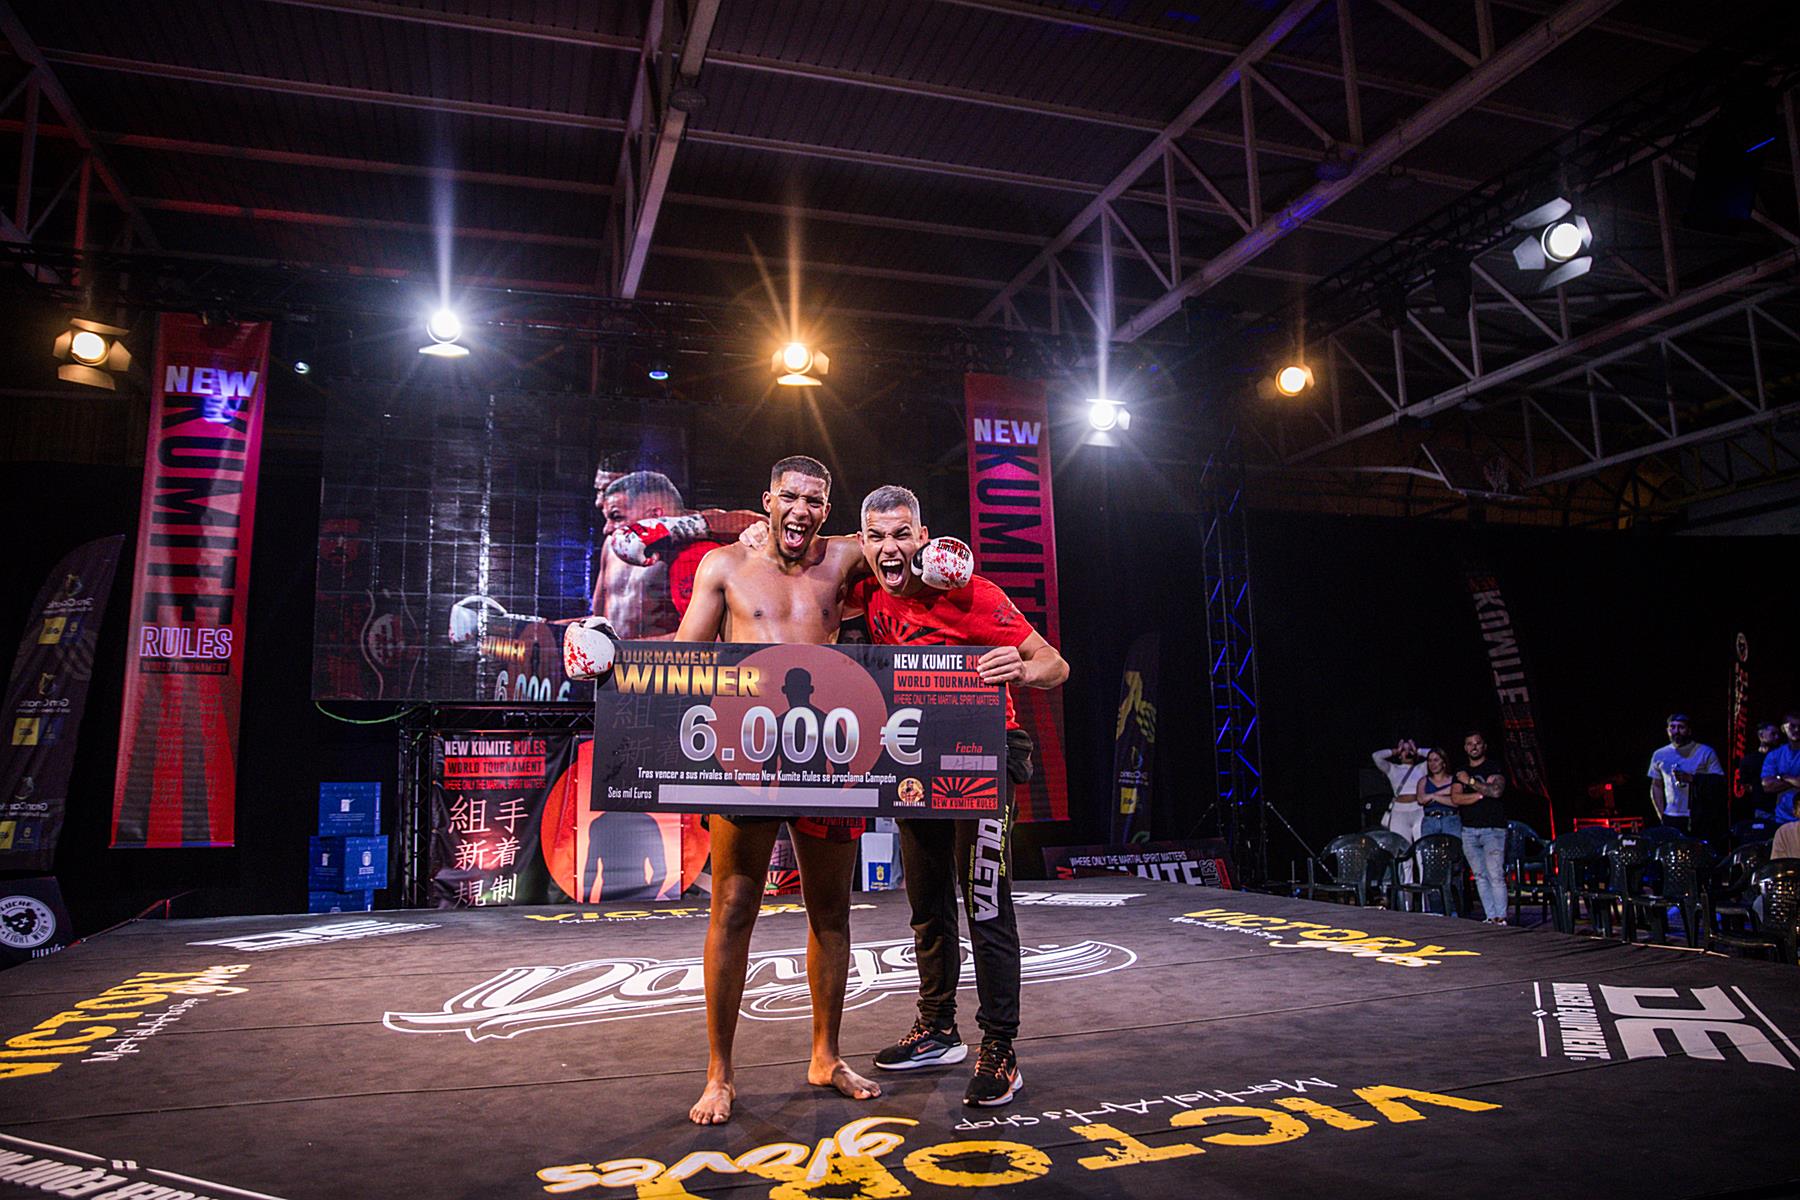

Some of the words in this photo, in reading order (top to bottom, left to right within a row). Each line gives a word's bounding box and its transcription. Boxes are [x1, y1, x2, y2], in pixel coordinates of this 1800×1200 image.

[164, 365, 258, 397] NEW
[974, 418, 1041, 445] NEW
[143, 394, 249, 626] KUMITE
[139, 626, 233, 659] RULES
[614, 651, 720, 665] TOURNAMENT
[1473, 589, 1530, 704] KUMITE
[894, 654, 919, 669] NEW
[922, 654, 963, 670] KUMITE
[614, 664, 760, 697] WINNER
[898, 676, 931, 687] WORLD
[445, 741, 468, 755] NEW
[471, 741, 511, 755] KUMITE
[513, 740, 546, 755] RULES
[680, 705, 859, 764] 6.000
[880, 708, 922, 765] €
[955, 742, 983, 753] Fecha
[448, 762, 480, 773] WORLD
[483, 761, 542, 773] TOURNAMENT
[638, 767, 653, 779] Tras
[655, 770, 678, 779] vencer
[680, 771, 684, 779] a
[686, 771, 698, 780] sus
[699, 769, 722, 780] rivales
[724, 772, 733, 780] en
[761, 770, 776, 781] New
[777, 770, 800, 782] Kumite
[802, 771, 820, 782] Rules
[822, 774, 830, 782] se
[832, 772, 864, 784] proclama
[608, 786, 621, 798] Seis
[622, 787, 633, 799] mil
[634, 787, 652, 799] Euros
[448, 794, 529, 834] 組手
[454, 836, 521, 871] 新着
[974, 818, 1003, 921] OLETA
[453, 873, 517, 908] 規制
[4, 932, 29, 943] FIGHT
[1184, 908, 1481, 957] VICTORY
[536, 1117, 920, 1194] gloves
